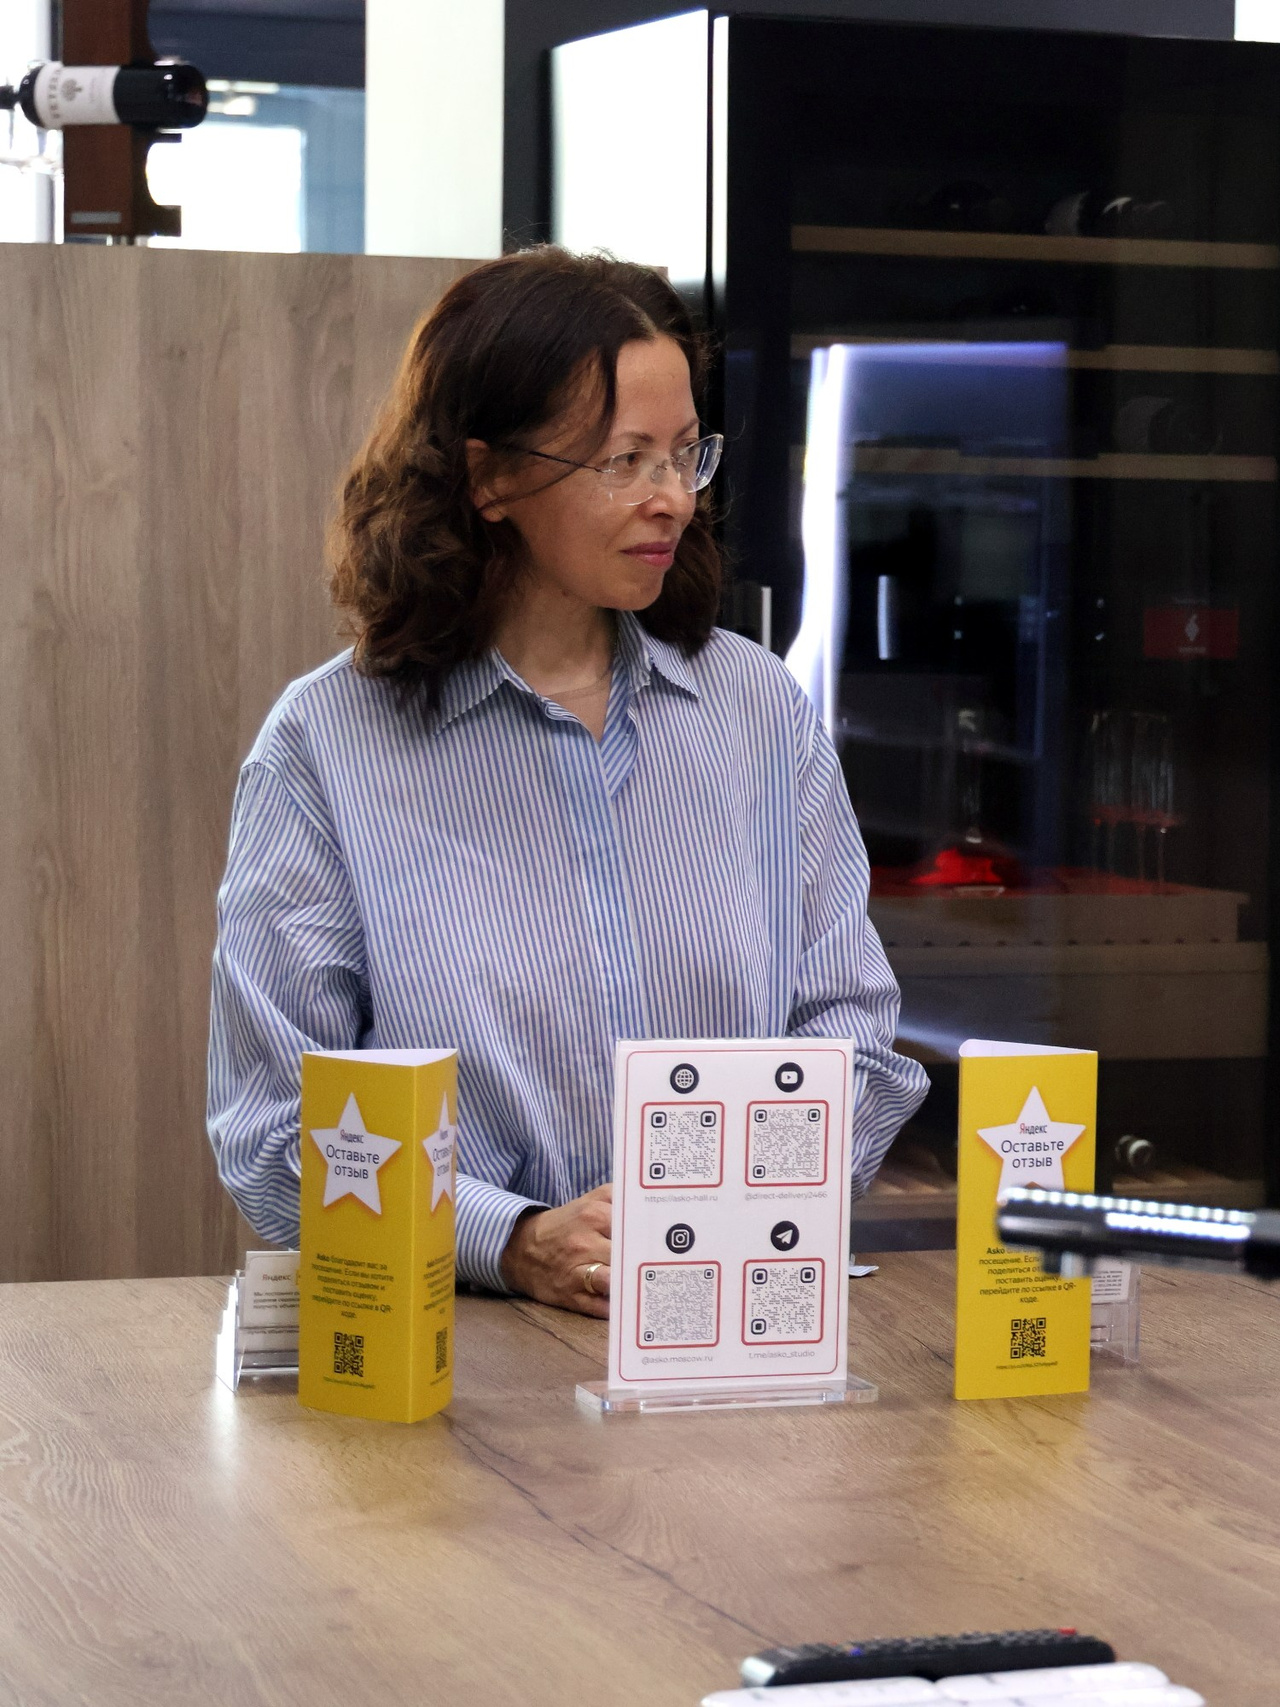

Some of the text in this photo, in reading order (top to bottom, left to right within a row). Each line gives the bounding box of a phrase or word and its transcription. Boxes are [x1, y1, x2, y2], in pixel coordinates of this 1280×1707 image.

[1020, 1122, 1048, 1135] Яндекс
[1001, 1139, 1065, 1153] Оставьте
[326, 1144, 380, 1165] Оставьте
[1012, 1156, 1053, 1168] отзыв
[334, 1165, 369, 1179] отзыв
